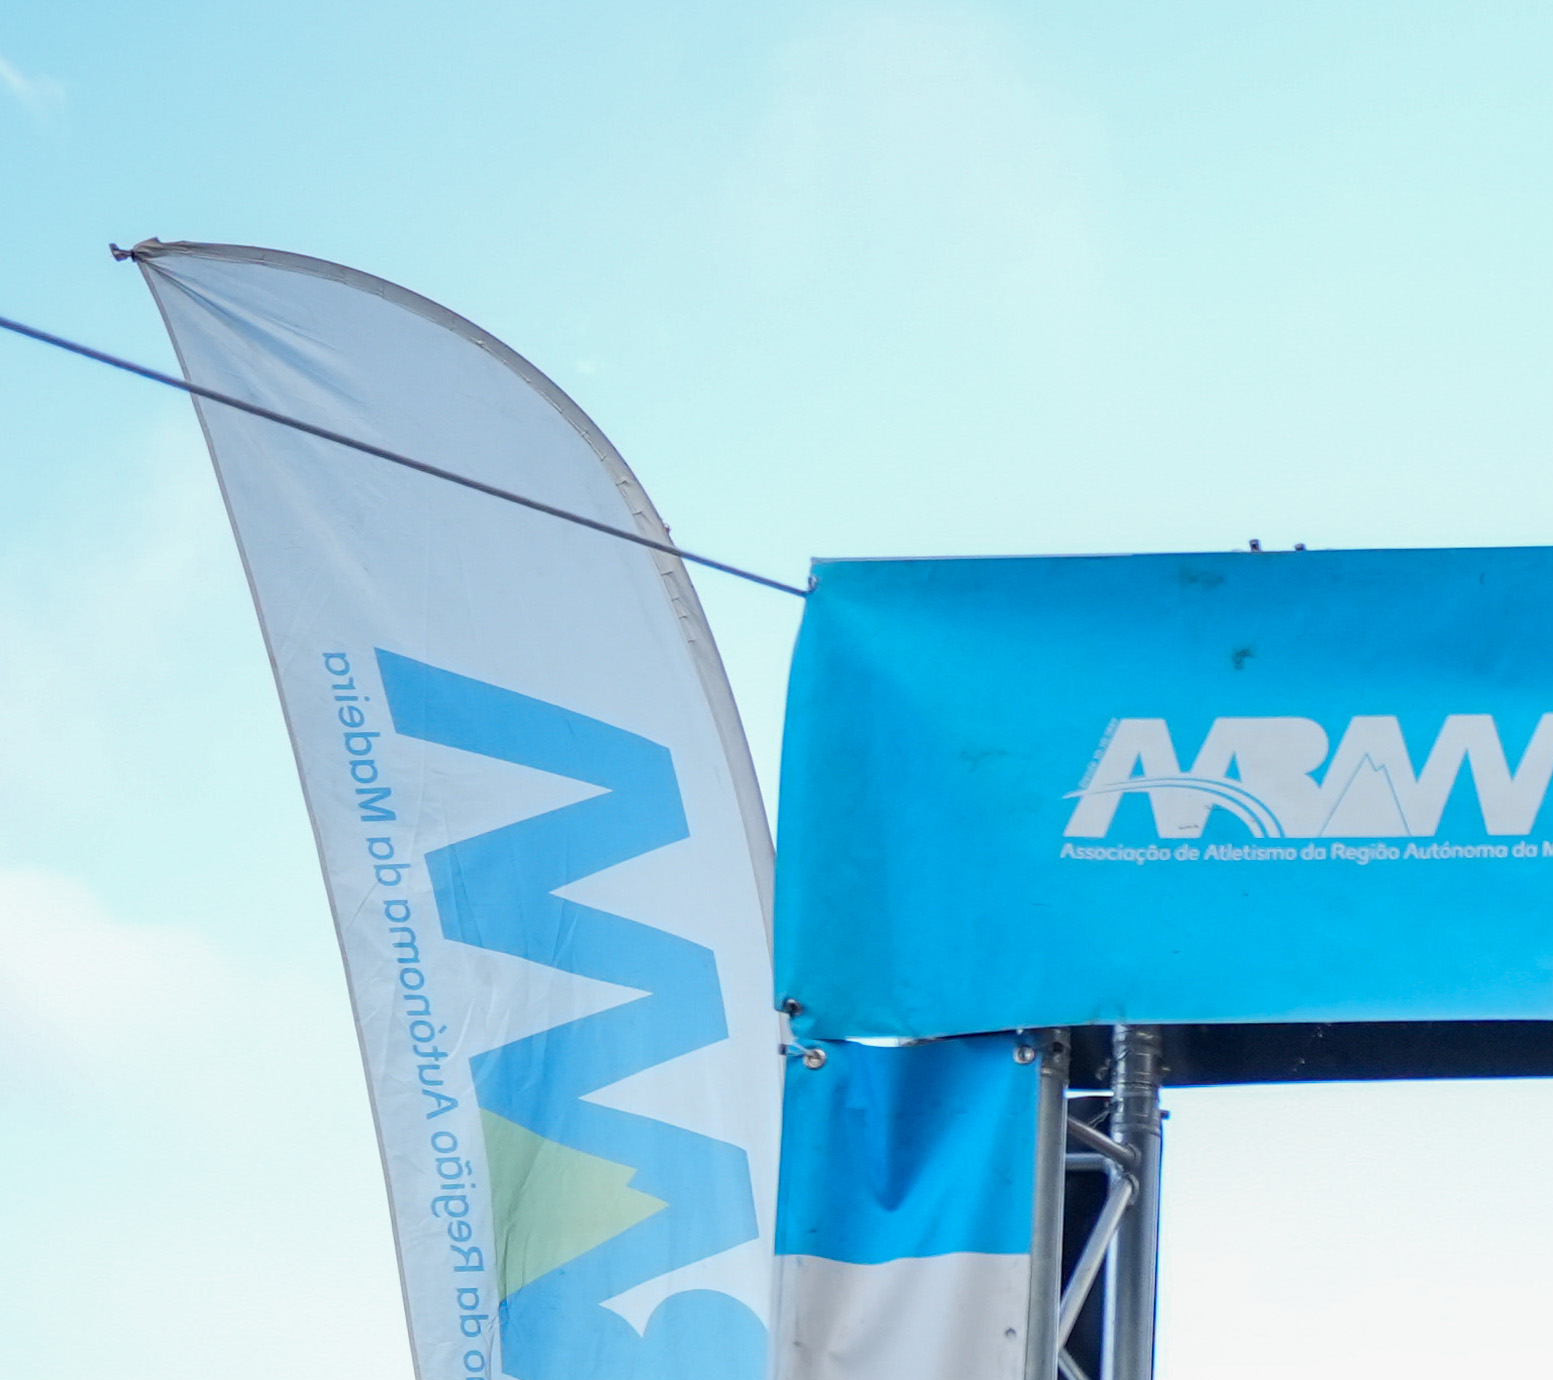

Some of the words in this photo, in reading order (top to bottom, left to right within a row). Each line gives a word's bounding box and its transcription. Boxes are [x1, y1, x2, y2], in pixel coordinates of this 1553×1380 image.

[1060, 843, 1171, 863] Associação
[1175, 845, 1200, 861] de
[1204, 843, 1297, 863] Atletismo
[1301, 844, 1327, 861] da
[1331, 843, 1400, 865] Região
[1403, 842, 1509, 860] Autónoma
[1512, 842, 1538, 859] da
